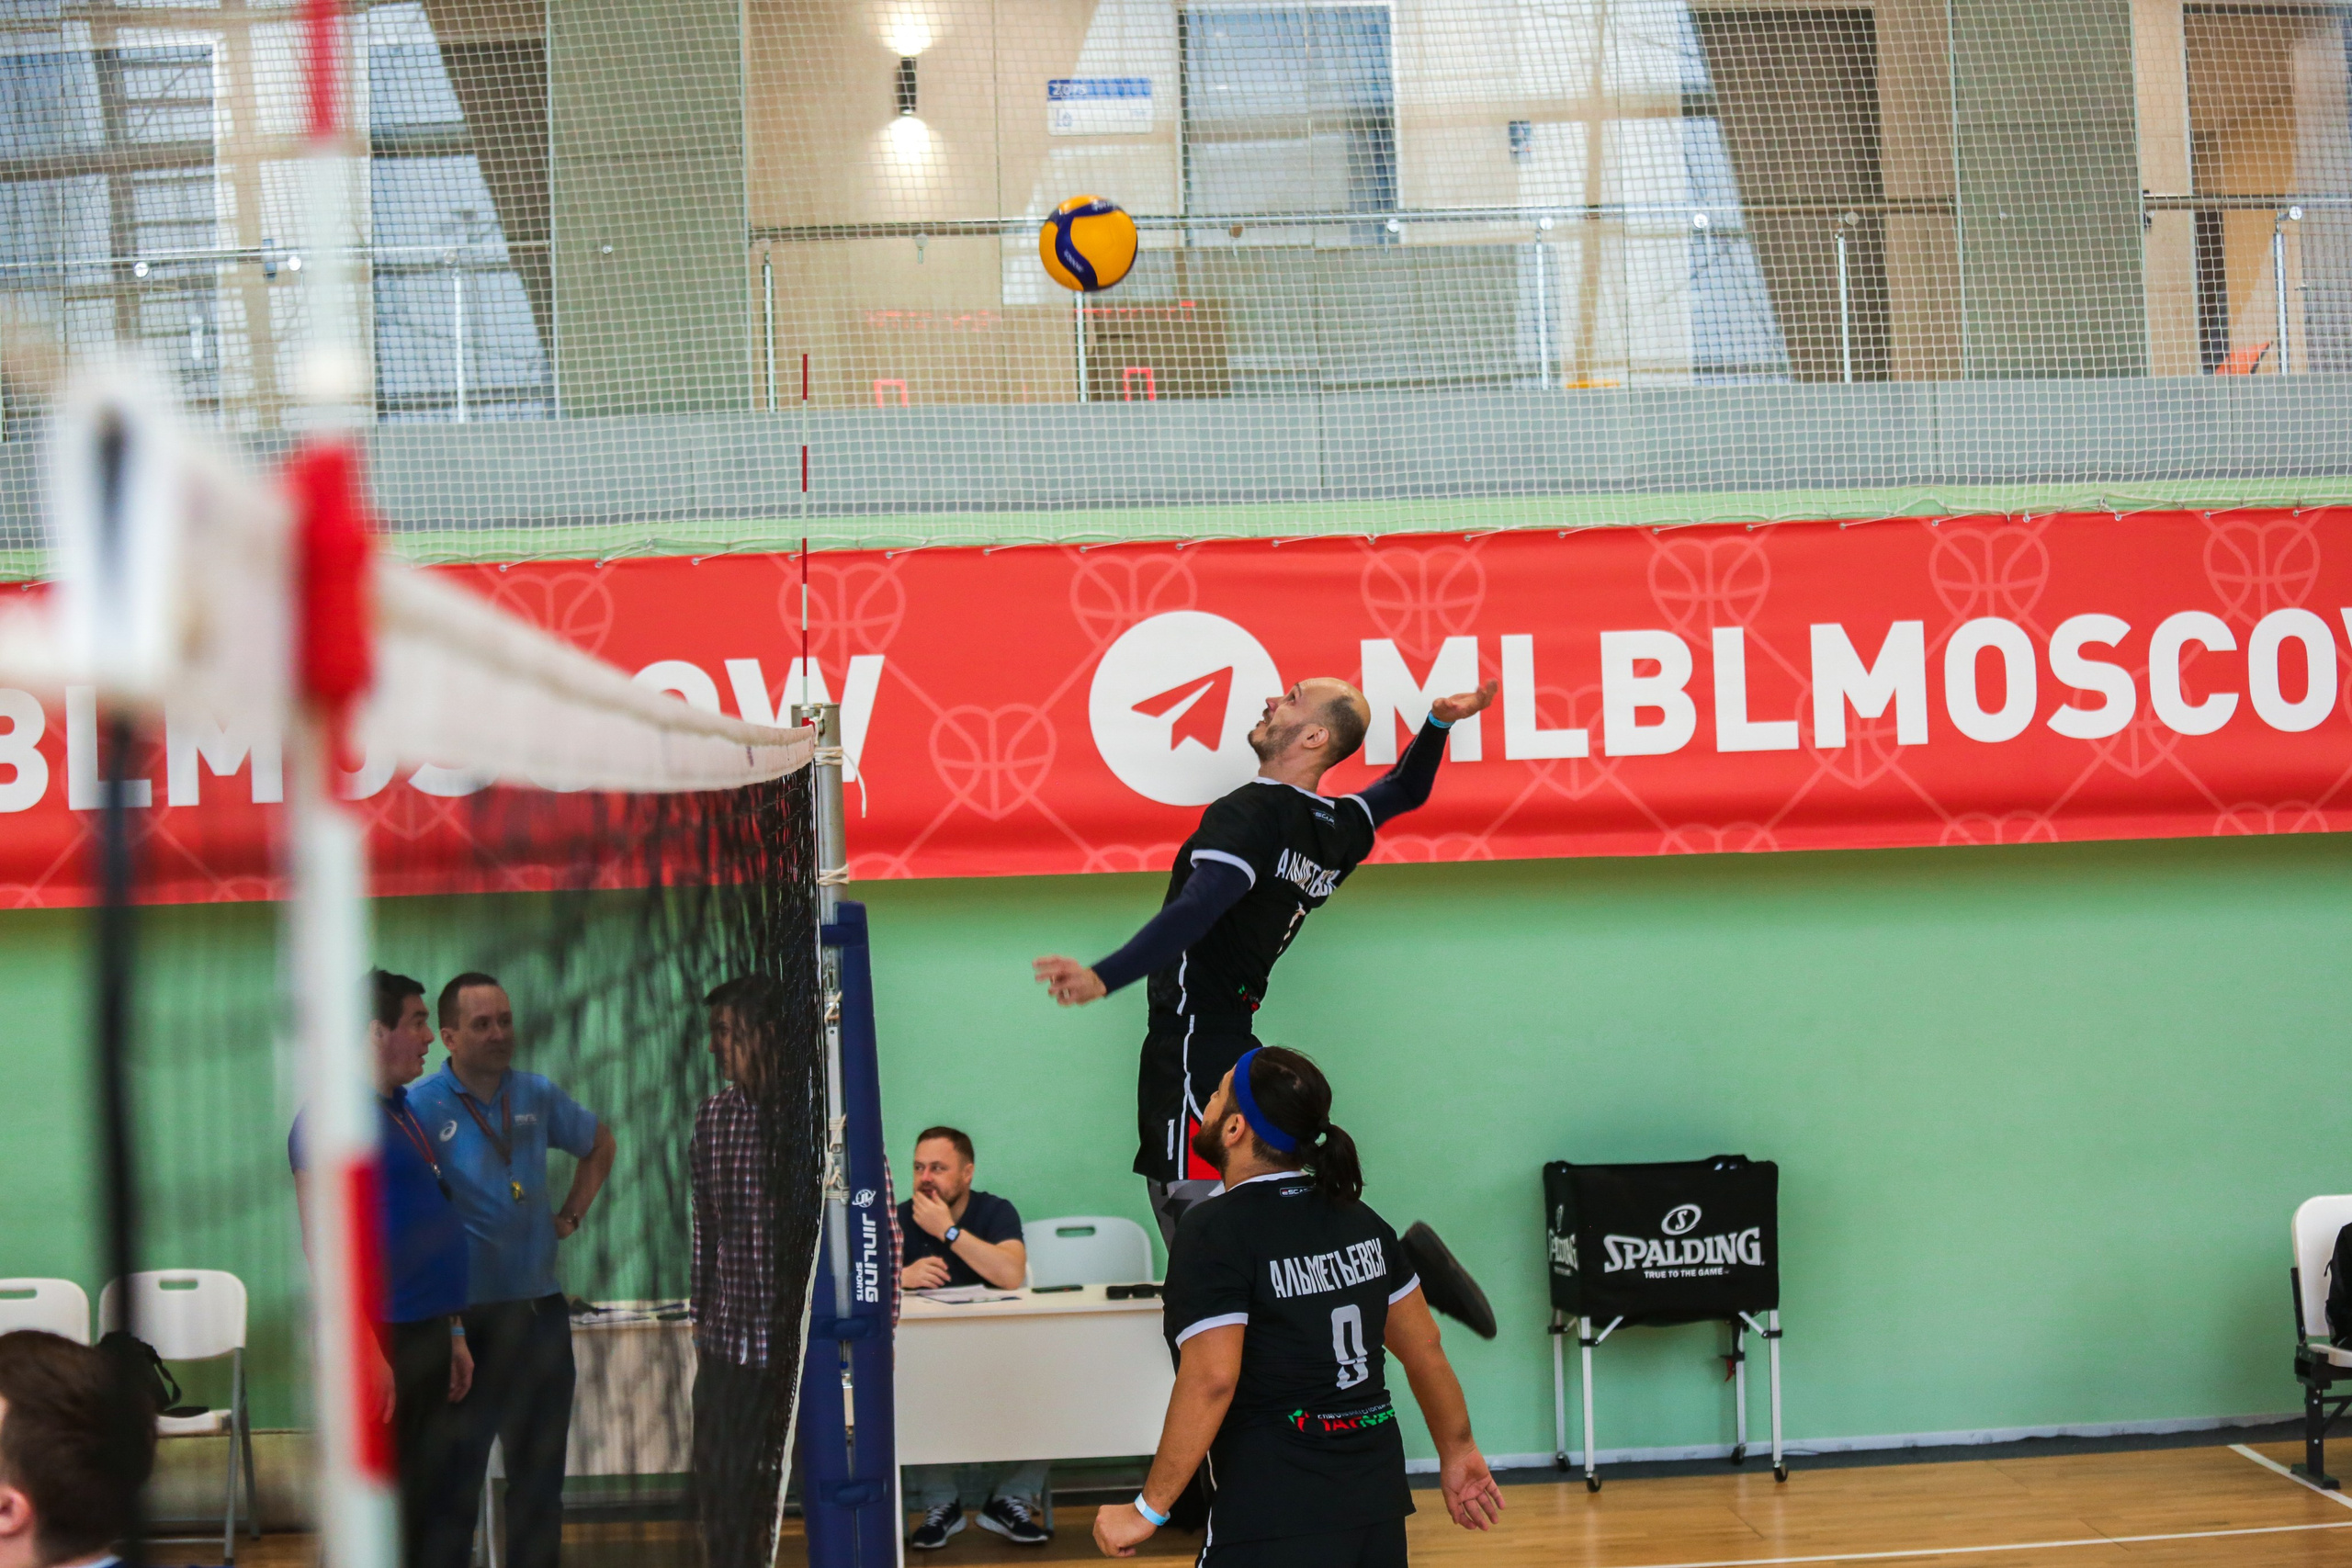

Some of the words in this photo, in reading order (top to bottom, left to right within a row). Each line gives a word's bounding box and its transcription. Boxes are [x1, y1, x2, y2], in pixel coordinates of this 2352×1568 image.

[1360, 607, 2352, 766] MLBLMOSCO
[1167, 1119, 1175, 1161] 1
[862, 1213, 878, 1303] JINLING
[1269, 1237, 1386, 1298] АЛЬМЕТЬЕВСК
[1603, 1226, 1761, 1273] SPALDING
[855, 1261, 864, 1302] SPORTS
[1644, 1269, 1667, 1280] TRUE
[1668, 1269, 1679, 1279] TO
[1680, 1269, 1697, 1278] THE
[1698, 1268, 1724, 1277] GAME
